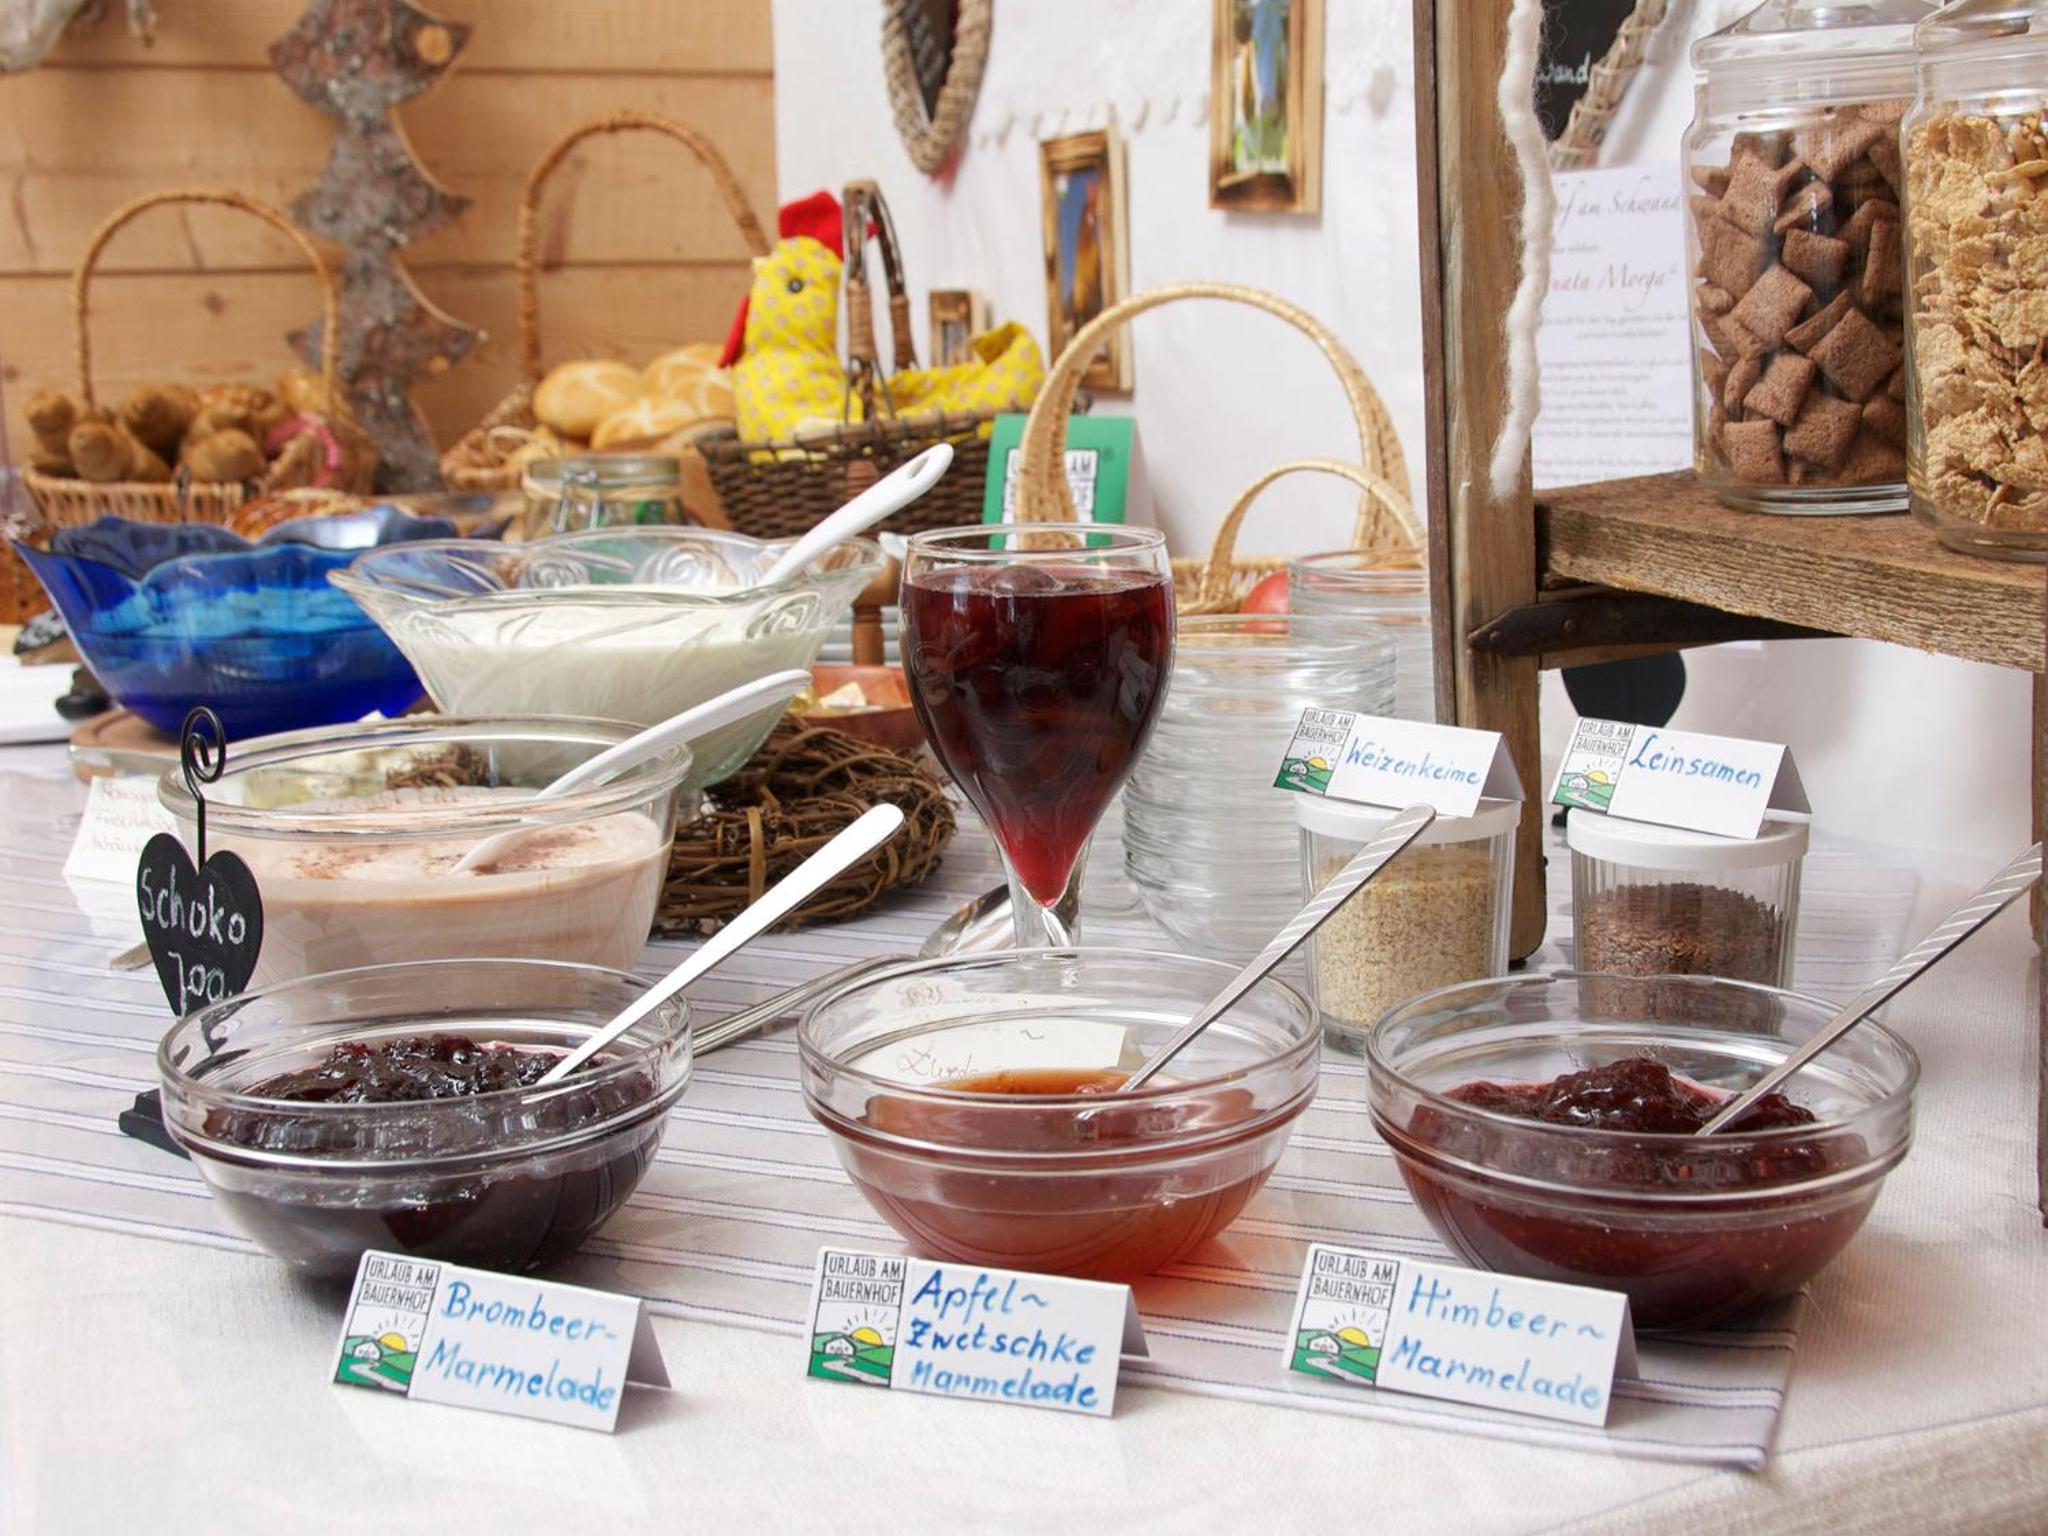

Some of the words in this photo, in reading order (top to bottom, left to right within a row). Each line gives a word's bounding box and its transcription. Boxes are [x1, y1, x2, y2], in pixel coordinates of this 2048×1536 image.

[1536, 51, 1591, 84] wand
[1305, 708, 1336, 726] URLAUB
[1337, 713, 1351, 728] AM
[1581, 719, 1614, 736] URLAUB
[1615, 724, 1631, 739] AM
[1298, 724, 1346, 745] BAUERNHOF
[1575, 736, 1626, 757] BAUERNHOF
[1345, 736, 1480, 785] Weizenkeime
[1629, 733, 1761, 790] Leinsamen
[140, 863, 246, 946] Schoko
[368, 1258, 412, 1283] URLAUB
[415, 1267, 435, 1287] AM
[827, 1255, 877, 1278] URLAUB
[881, 1260, 902, 1280] AM
[1317, 1254, 1369, 1278] URLAUB
[1371, 1261, 1394, 1282] AM
[361, 1283, 430, 1312] BAUERNHOF
[824, 1278, 900, 1303] BAUERNHOF
[1311, 1277, 1390, 1307] BAUERNHOF
[440, 1280, 619, 1342] Brombeer-
[905, 1317, 1096, 1366] Zwetschke
[425, 1338, 617, 1412] Marmelade
[908, 1360, 1099, 1411] Marmelade
[1389, 1336, 1602, 1411] Marmelade
